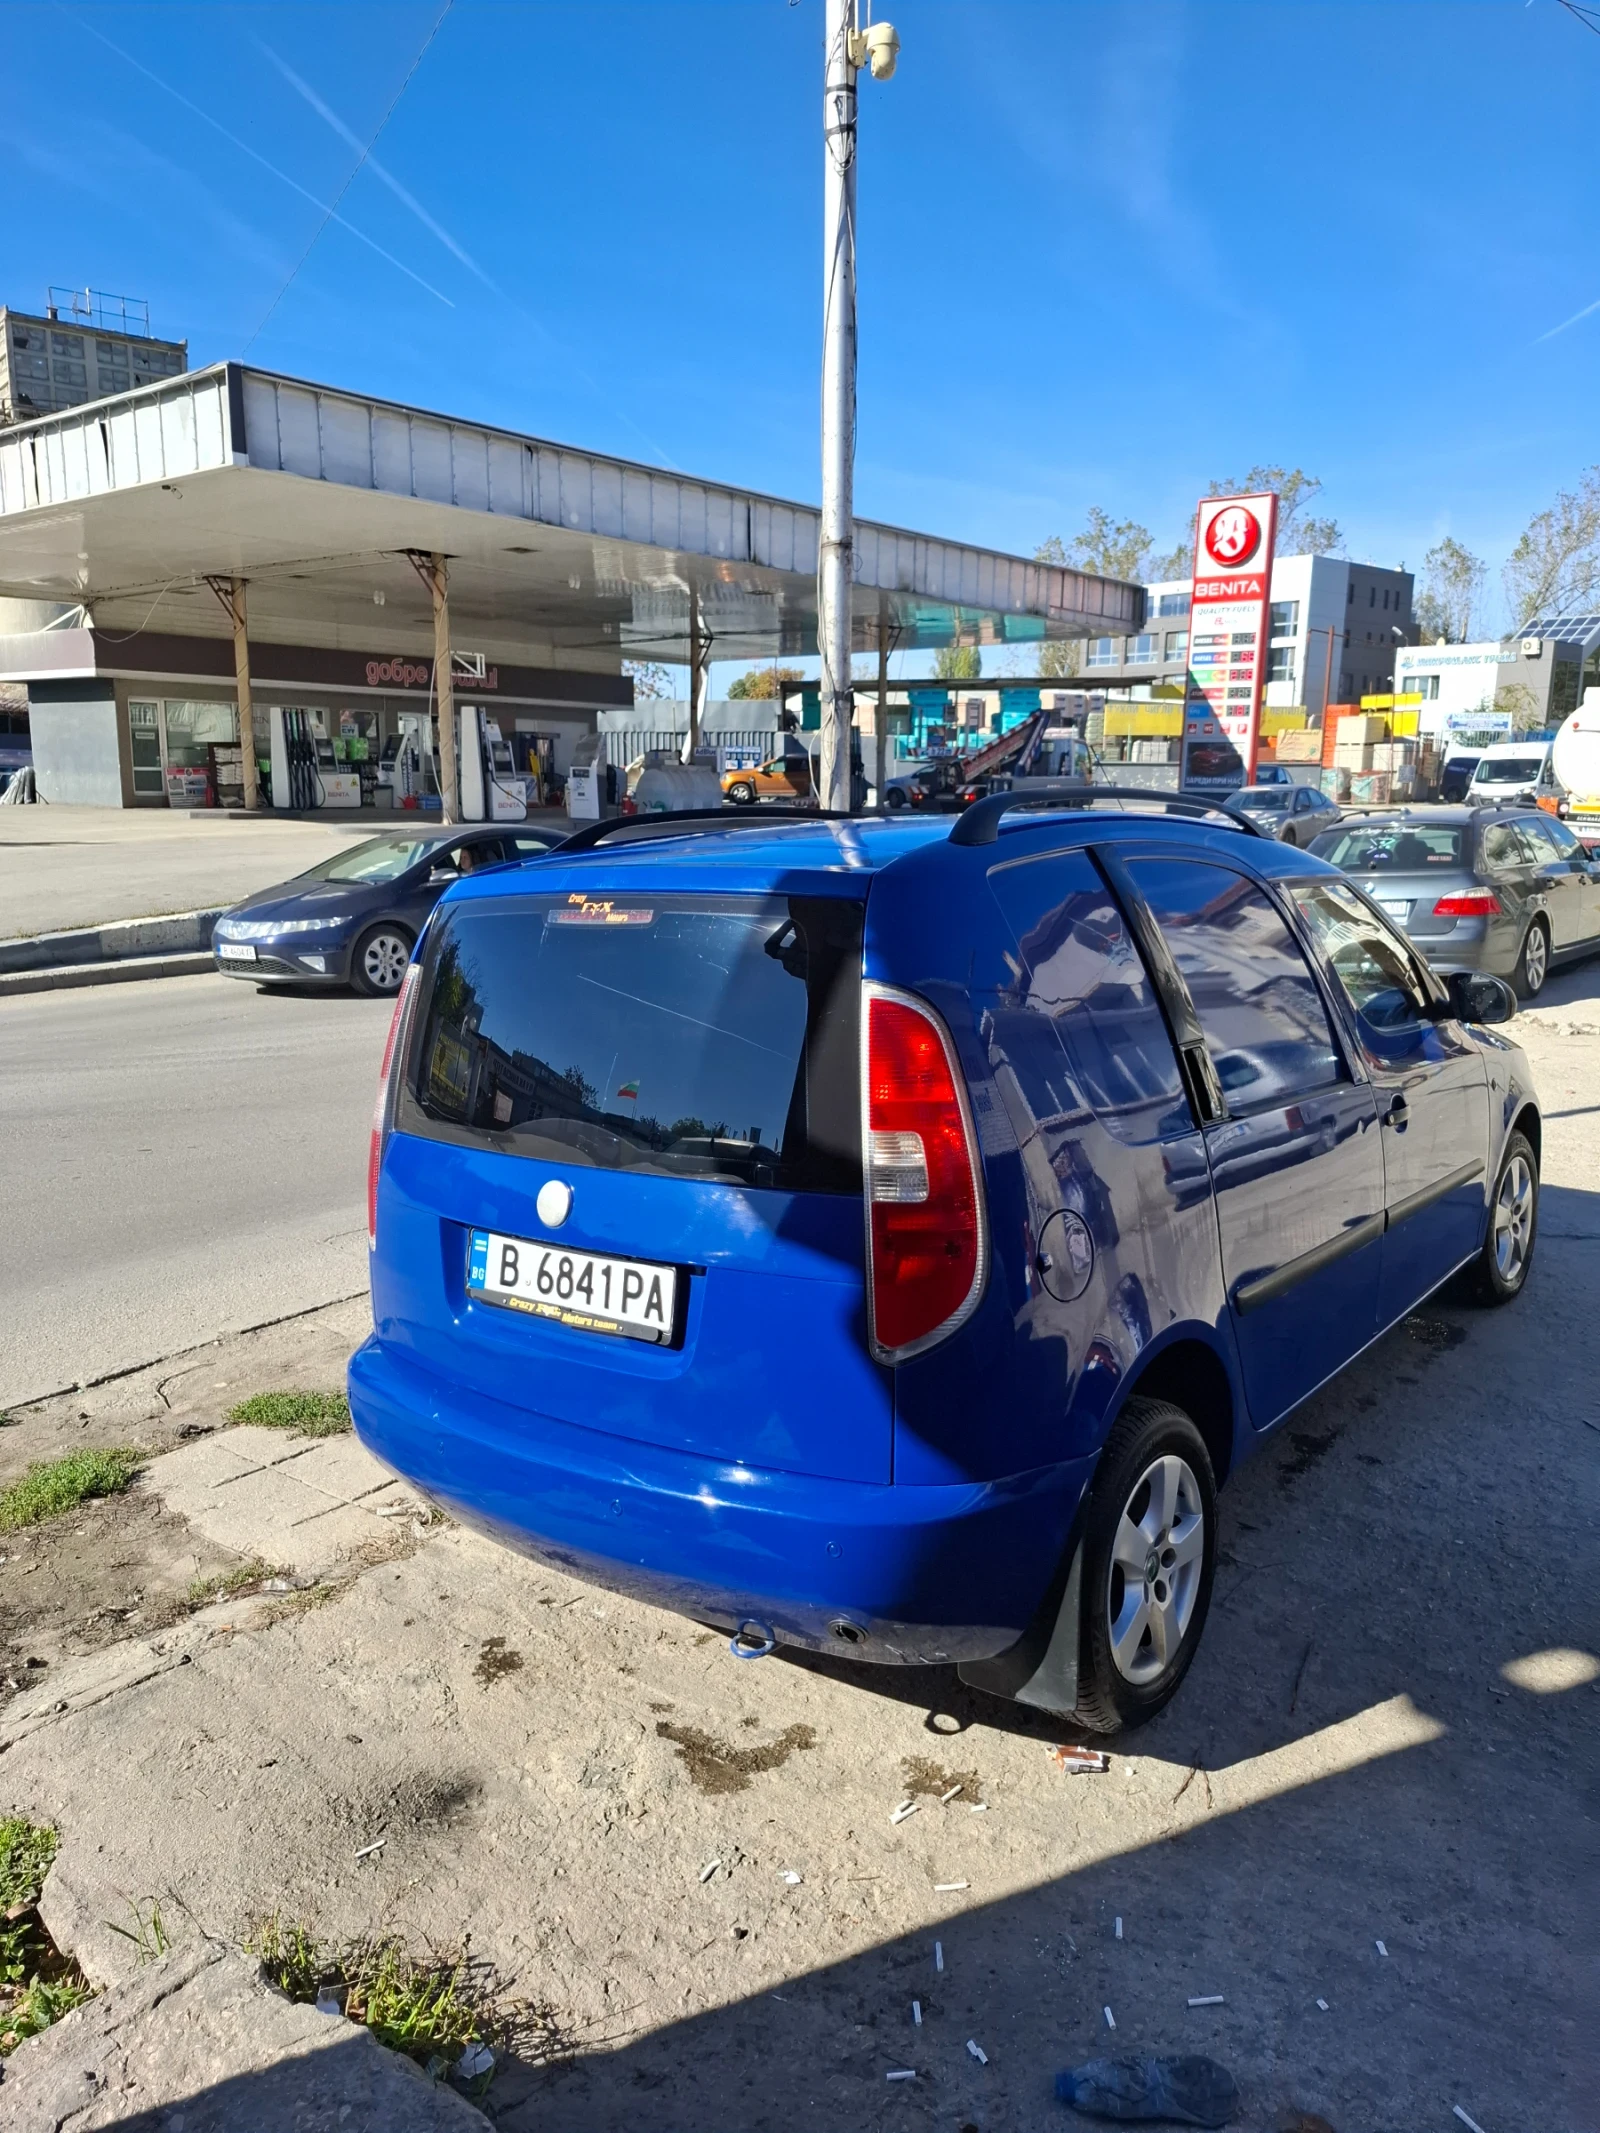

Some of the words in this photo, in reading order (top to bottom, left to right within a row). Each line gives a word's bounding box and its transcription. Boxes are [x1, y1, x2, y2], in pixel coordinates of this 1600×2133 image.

[1195, 580, 1260, 597] BENITA
[1198, 607, 1230, 615] QUALITY
[366, 657, 428, 688] добре
[471, 1266, 485, 1280] BG
[499, 1243, 520, 1287] B
[509, 1297, 535, 1312] Crazy
[561, 1313, 593, 1326] Motors
